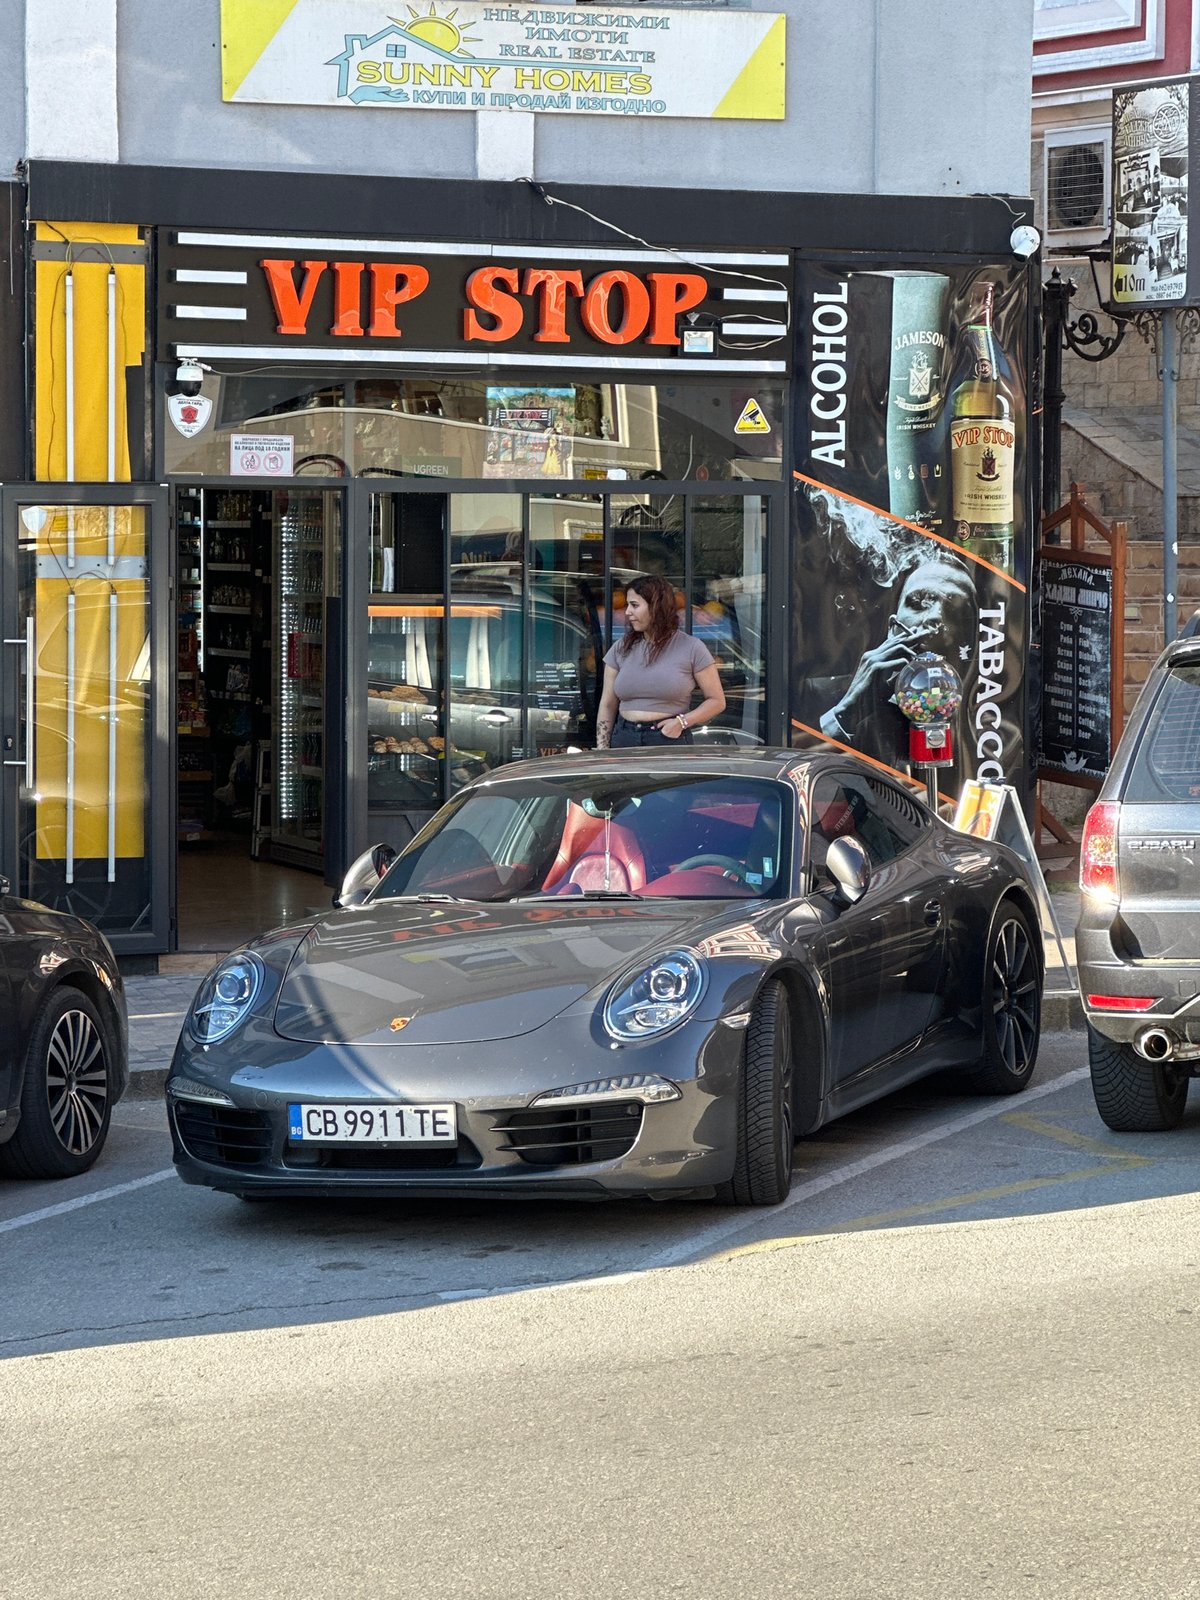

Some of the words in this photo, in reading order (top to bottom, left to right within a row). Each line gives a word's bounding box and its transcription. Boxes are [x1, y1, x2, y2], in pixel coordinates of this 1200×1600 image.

[483, 7, 670, 29] НЕДВИЖИМИ
[525, 26, 629, 44] ИМОТИ
[499, 43, 563, 59] REAL
[568, 47, 656, 63] ESTATE
[356, 60, 500, 88] SUNNY
[514, 69, 653, 95] HOMES
[412, 90, 466, 105] КУПИ
[472, 92, 484, 105] И
[491, 92, 571, 110] ПРОДАЙ
[576, 96, 667, 114] ИЗГОДНО
[1123, 273, 1145, 292] 10m
[259, 258, 430, 337] VIP
[463, 266, 708, 345] STOP
[895, 331, 946, 351] JAMESON
[811, 282, 849, 468] ALCOHOL
[953, 427, 980, 448] VIP
[983, 426, 1014, 448] STOP
[413, 464, 448, 475] UGREEN
[1061, 566, 1093, 586] МЕХАНА
[975, 602, 1006, 781] TABACCO
[1127, 840, 1196, 850] SUBARU
[291, 1126, 302, 1135] BG
[306, 1109, 339, 1137] CB
[344, 1109, 405, 1137] 9911
[414, 1109, 450, 1137] TE
